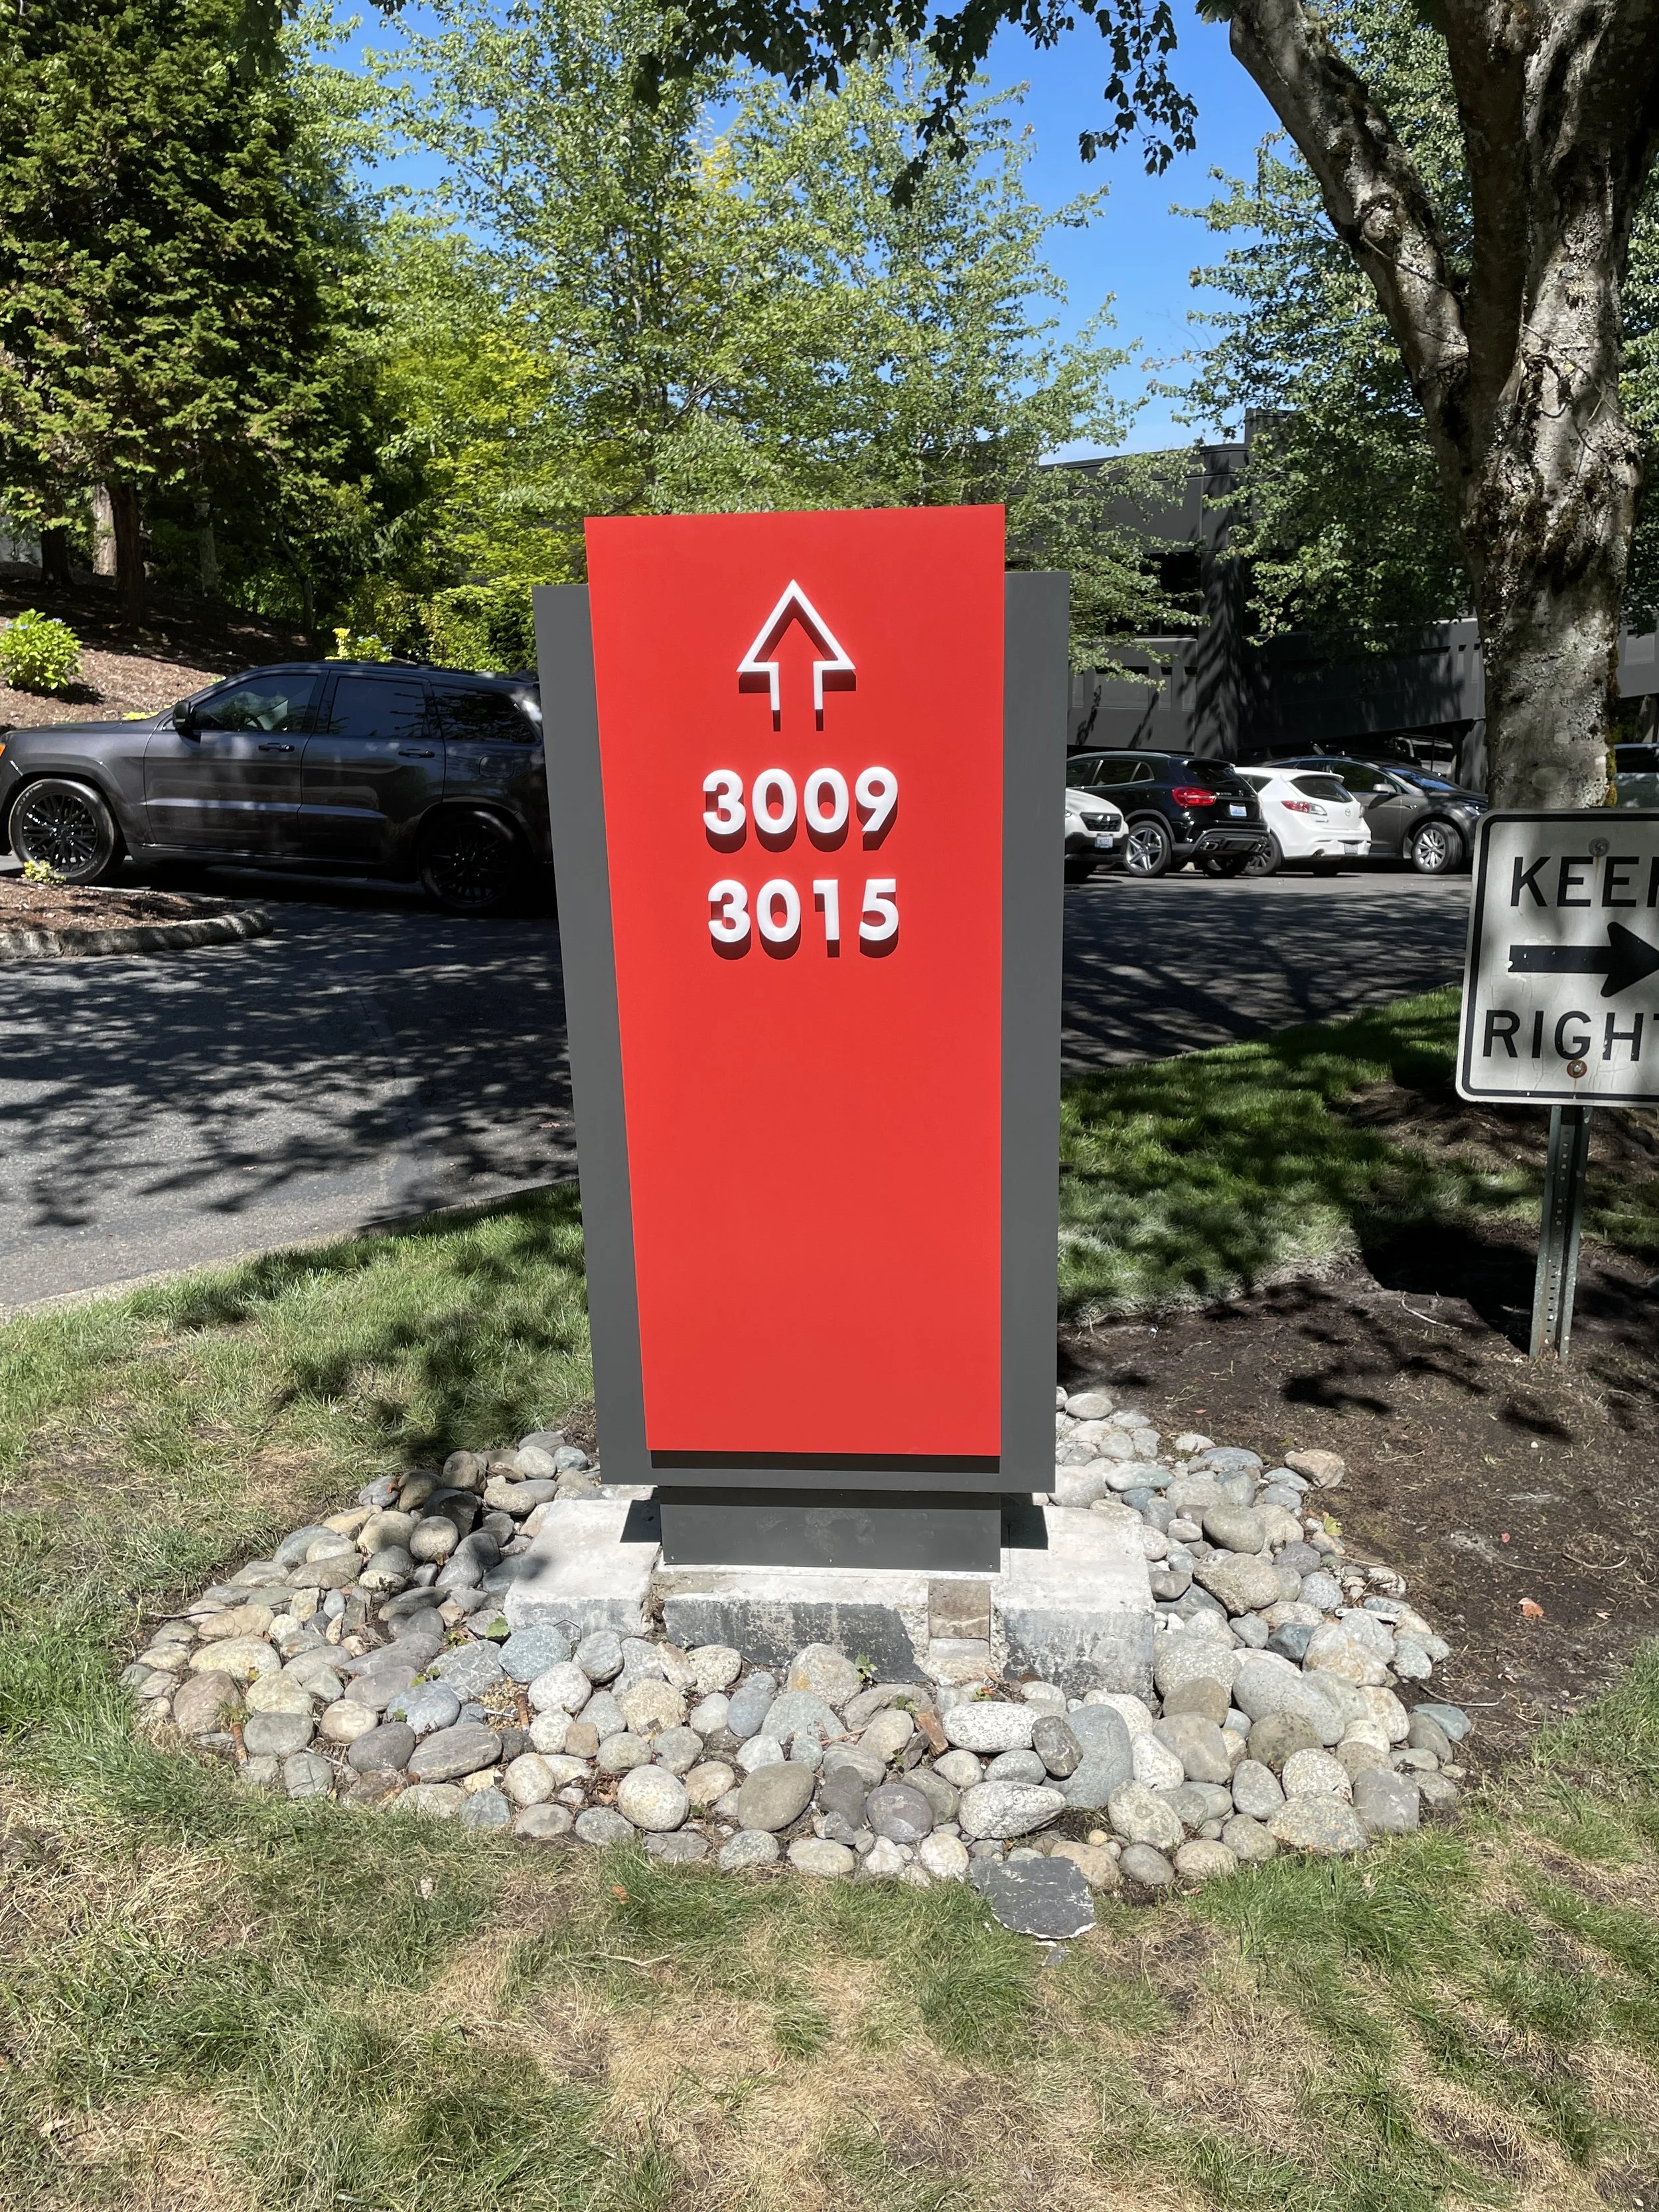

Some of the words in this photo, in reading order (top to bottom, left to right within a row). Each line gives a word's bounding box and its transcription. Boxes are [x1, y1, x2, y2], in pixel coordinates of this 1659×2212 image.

[703, 767, 898, 834] 3009
[708, 879, 899, 942] 3015
[1482, 1010, 1659, 1061] RIGH
